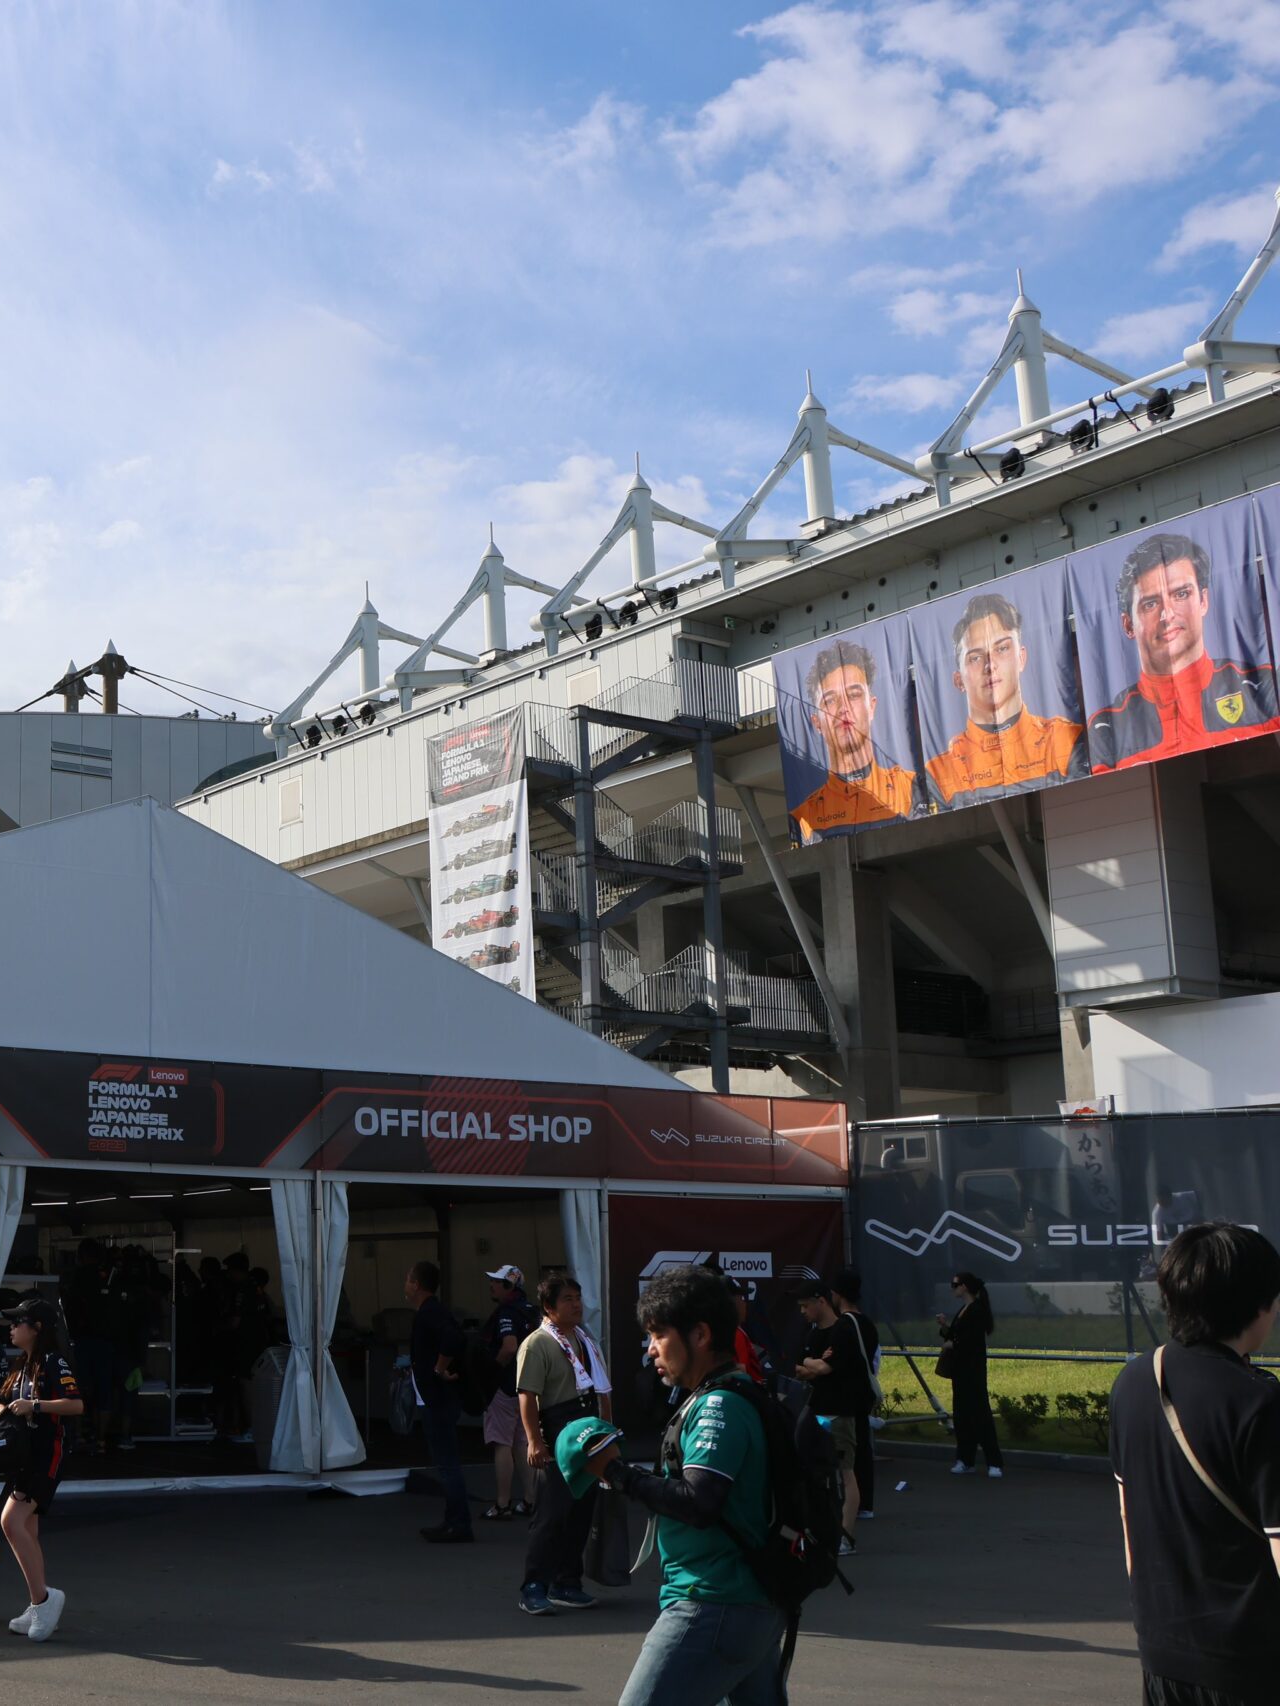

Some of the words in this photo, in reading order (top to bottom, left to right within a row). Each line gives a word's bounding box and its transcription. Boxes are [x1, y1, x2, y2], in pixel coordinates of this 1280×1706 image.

[442, 753, 472, 769] LENOVO
[442, 759, 482, 778] JAPANESE
[442, 771, 470, 787] GRAND
[150, 1070, 185, 1082] Lenovo
[88, 1080, 166, 1098] FORMULA
[169, 1087, 178, 1099] 1
[88, 1095, 151, 1111] LENOVO
[88, 1110, 168, 1126] JAPANESE
[354, 1106, 501, 1141] OFFICIAL
[508, 1114, 592, 1144] SHOP
[88, 1125, 145, 1140] GRAND
[147, 1128, 184, 1142] PRIX
[695, 1134, 742, 1145] SUZUKA
[744, 1136, 788, 1148] CIRCUIT
[88, 1139, 127, 1152] 2023
[723, 1257, 768, 1271] Lenovo
[696, 1439, 718, 1451] BOSS
